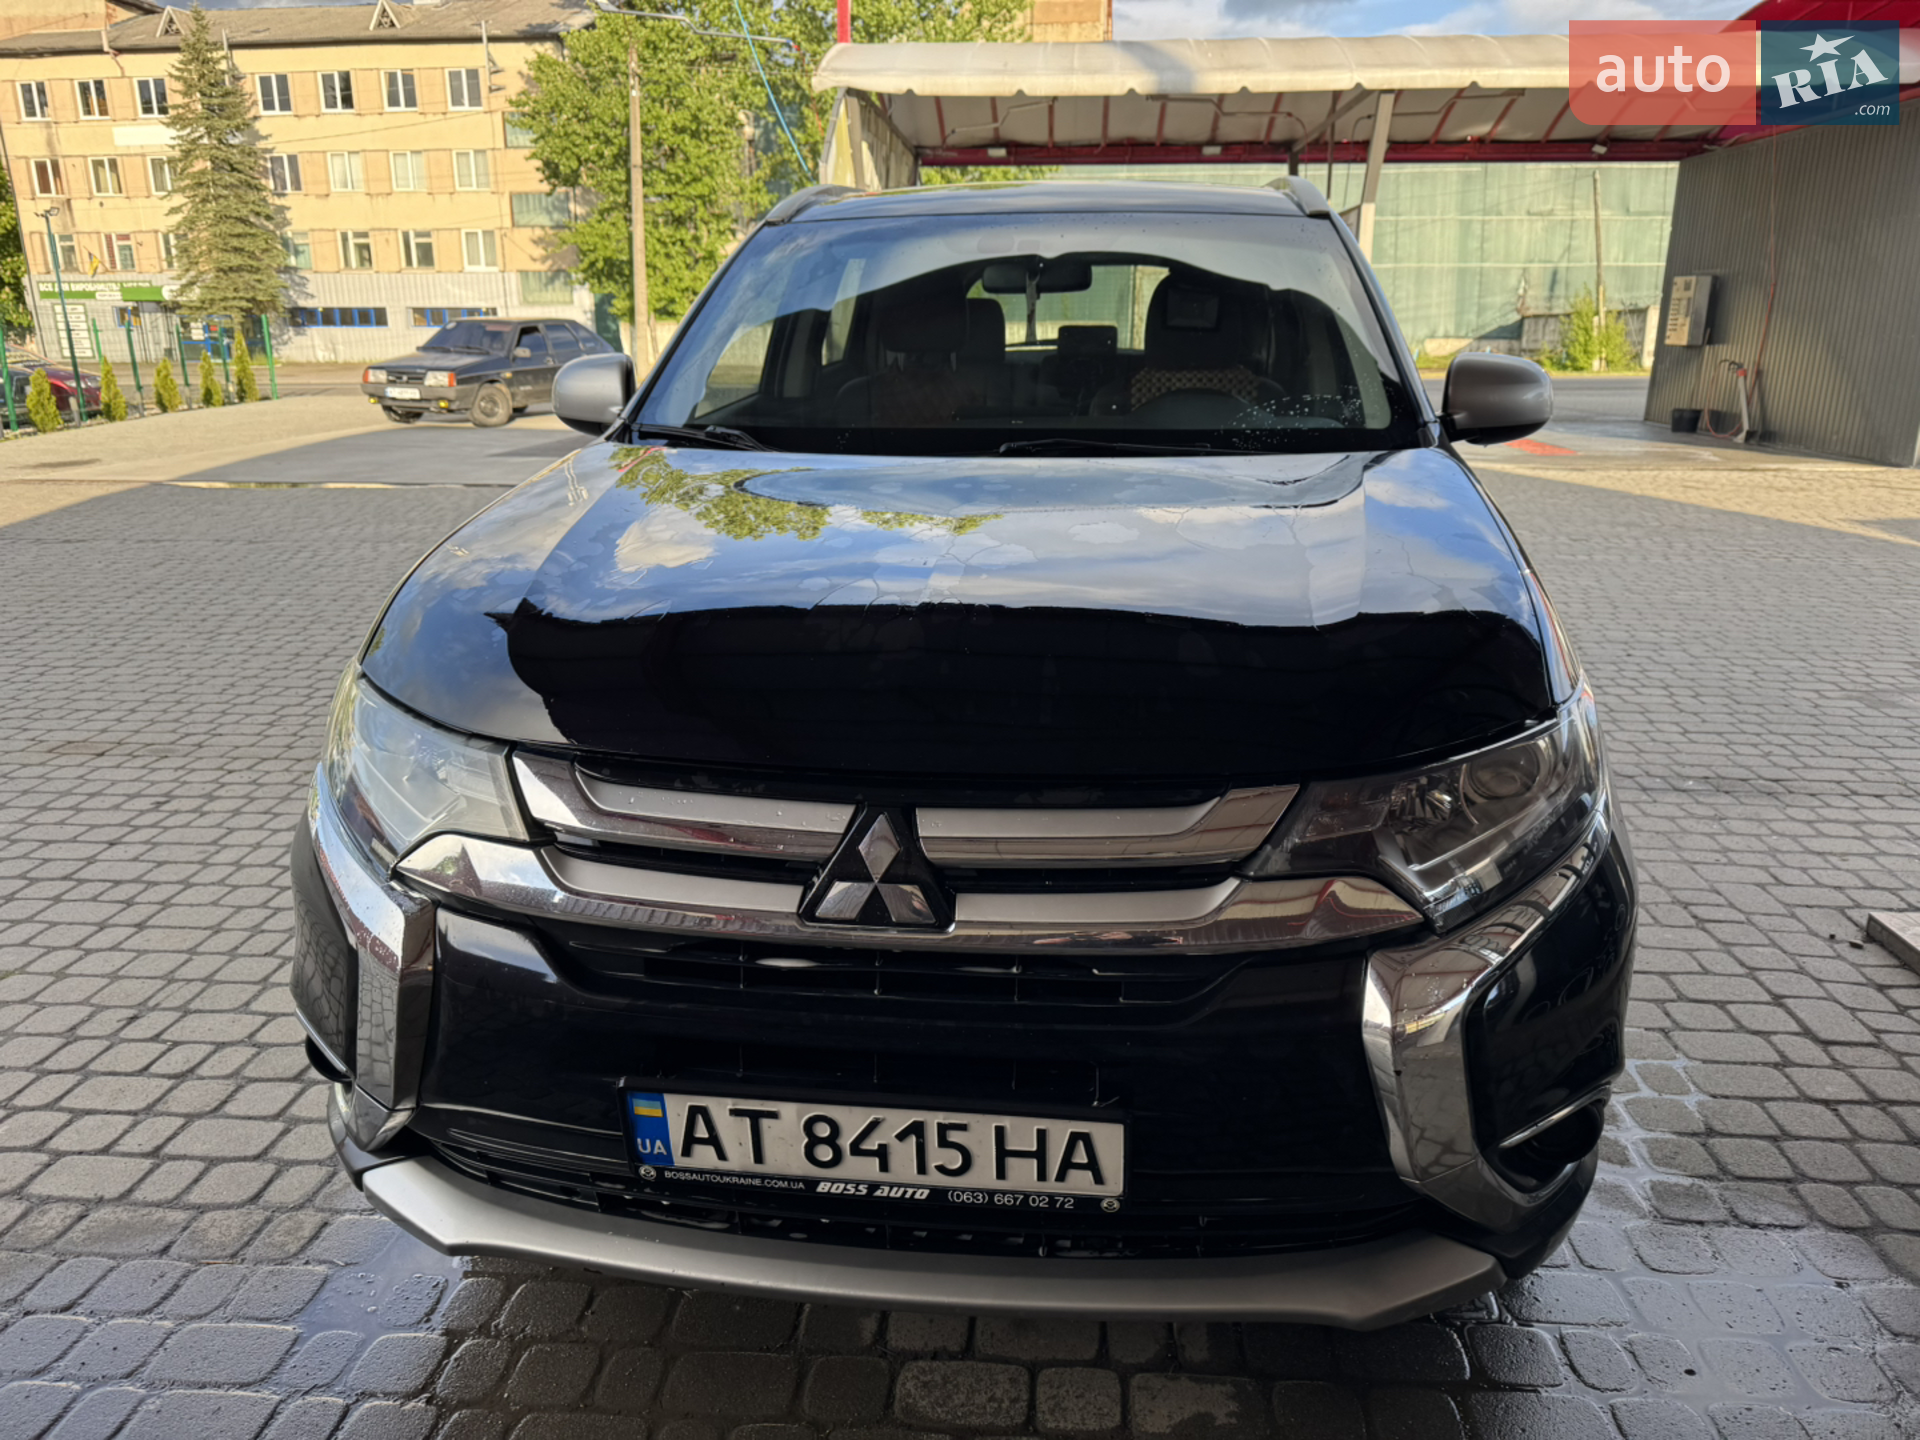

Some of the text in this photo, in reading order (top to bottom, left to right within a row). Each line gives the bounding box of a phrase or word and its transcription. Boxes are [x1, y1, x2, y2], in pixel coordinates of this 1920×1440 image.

[636, 1137, 668, 1157] UA
[680, 1103, 1106, 1187] AT 8415 HA
[664, 1169, 1075, 1210] BOSSAUTOUKRAINE.COM.UA BOSS AUTO (063) 667 02 72
